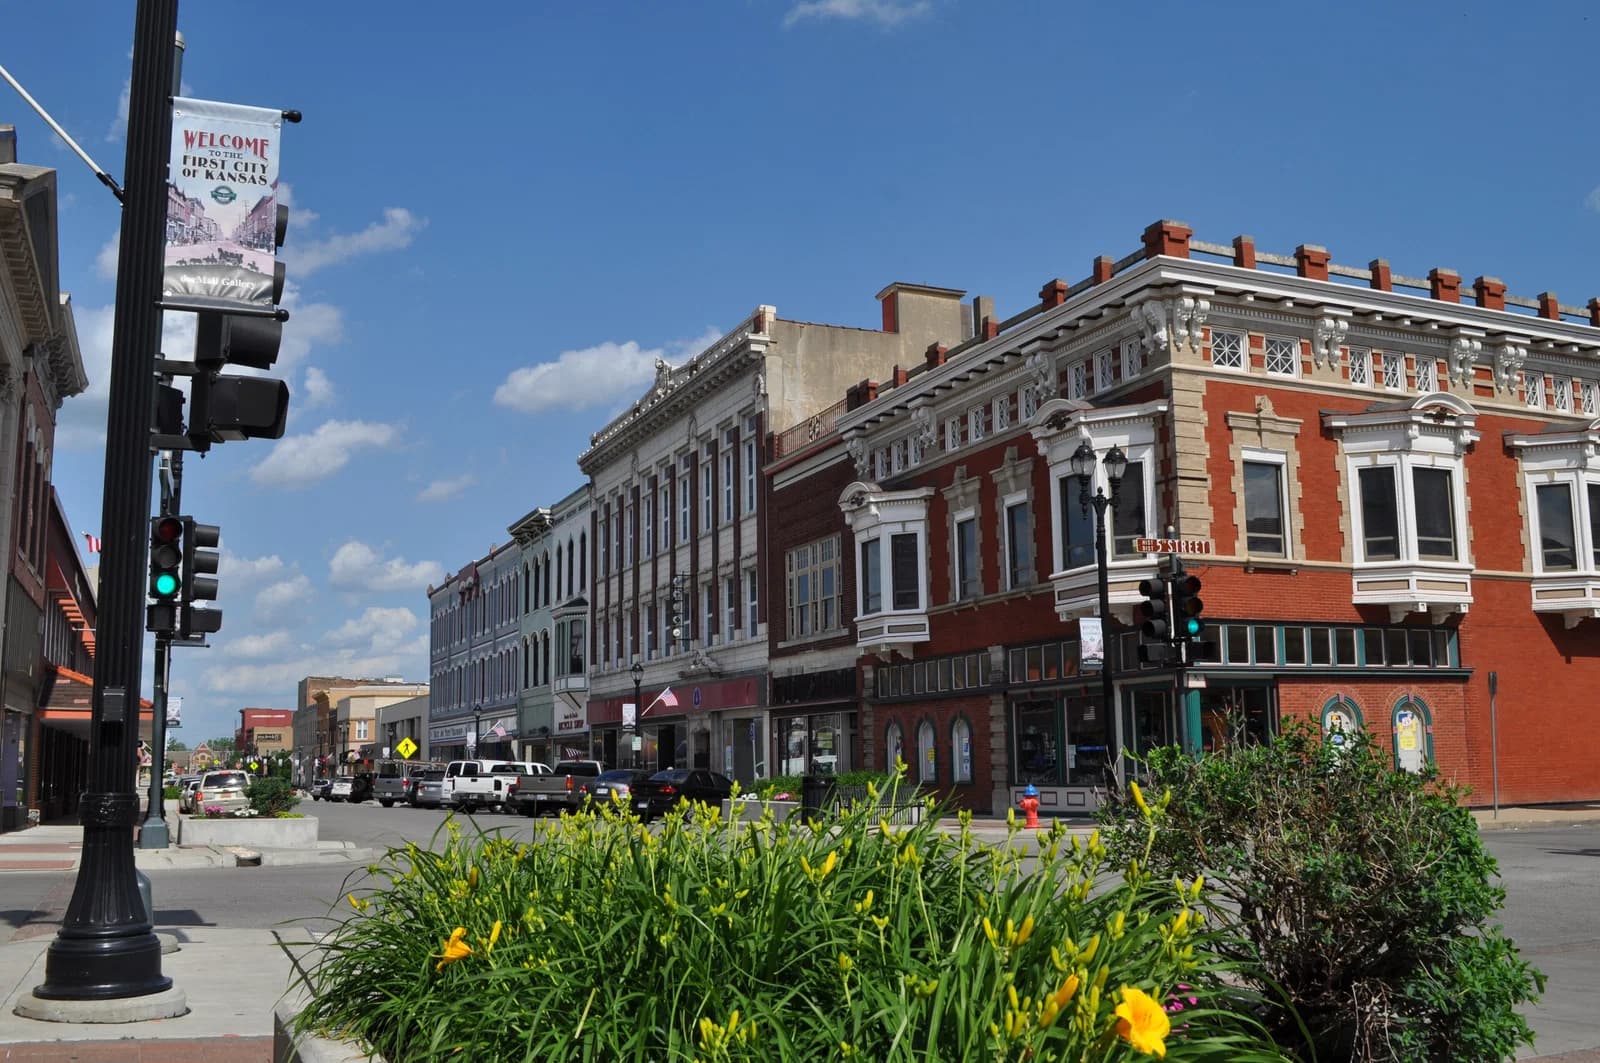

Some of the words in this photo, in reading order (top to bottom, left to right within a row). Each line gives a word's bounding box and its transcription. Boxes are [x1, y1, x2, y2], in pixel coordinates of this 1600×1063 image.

[183, 130, 269, 161] WELCOME
[208, 149, 221, 157] TO
[222, 151, 244, 159] THE
[182, 155, 227, 170] FIRST
[234, 161, 269, 174] CITY
[182, 168, 199, 178] OF
[205, 169, 267, 186] KANSAS
[222, 278, 255, 290] Gallery
[1167, 540, 1207, 554] STREET
